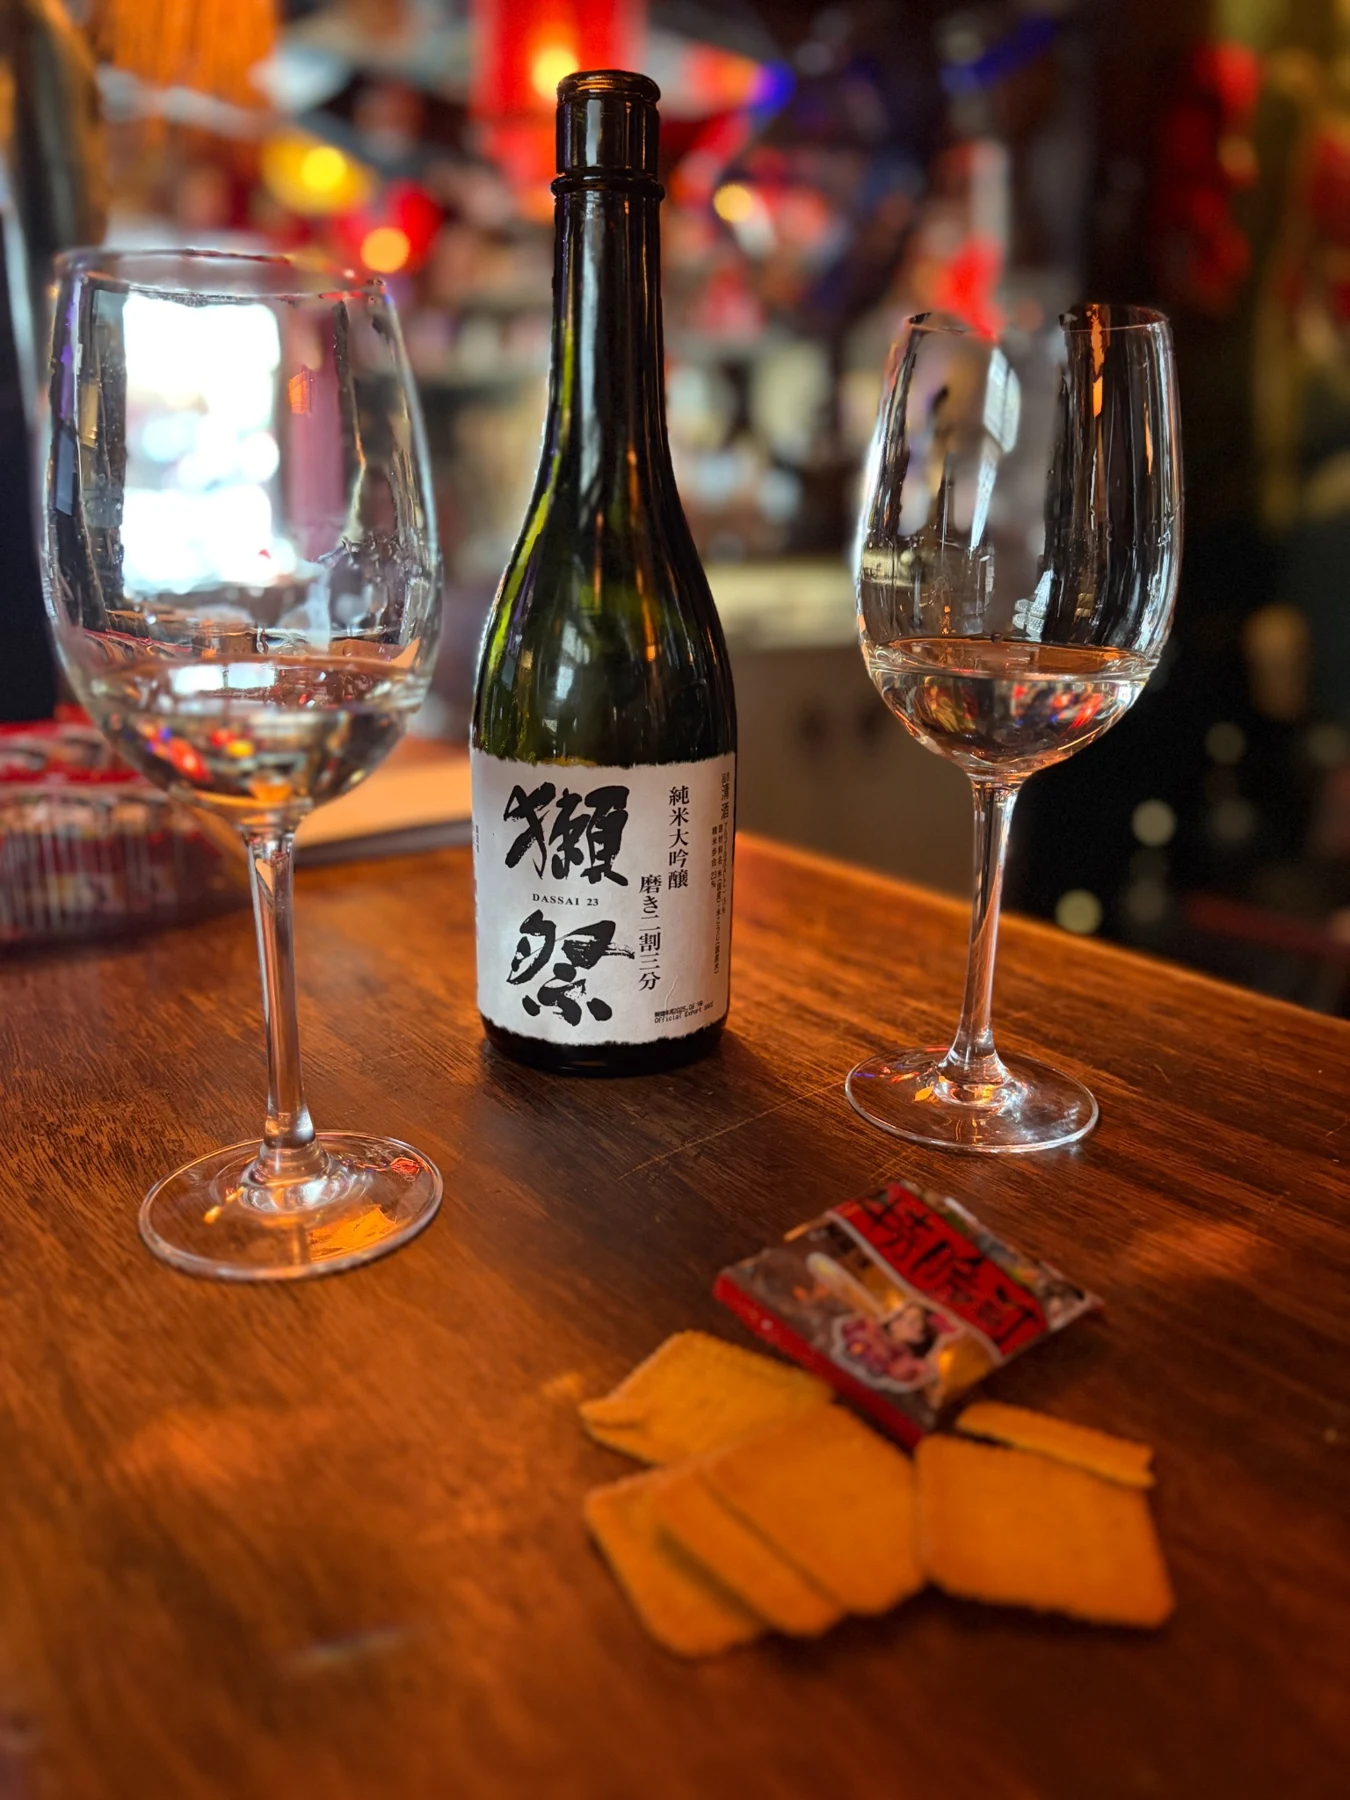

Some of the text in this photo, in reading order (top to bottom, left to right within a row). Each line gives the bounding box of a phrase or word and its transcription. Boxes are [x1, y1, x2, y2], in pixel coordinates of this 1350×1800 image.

[667, 785, 690, 890] 純米大吟醸
[532, 893, 599, 906] DASSAI 23
[638, 873, 663, 992] 磨き二割三分
[654, 1011, 682, 1024] Official
